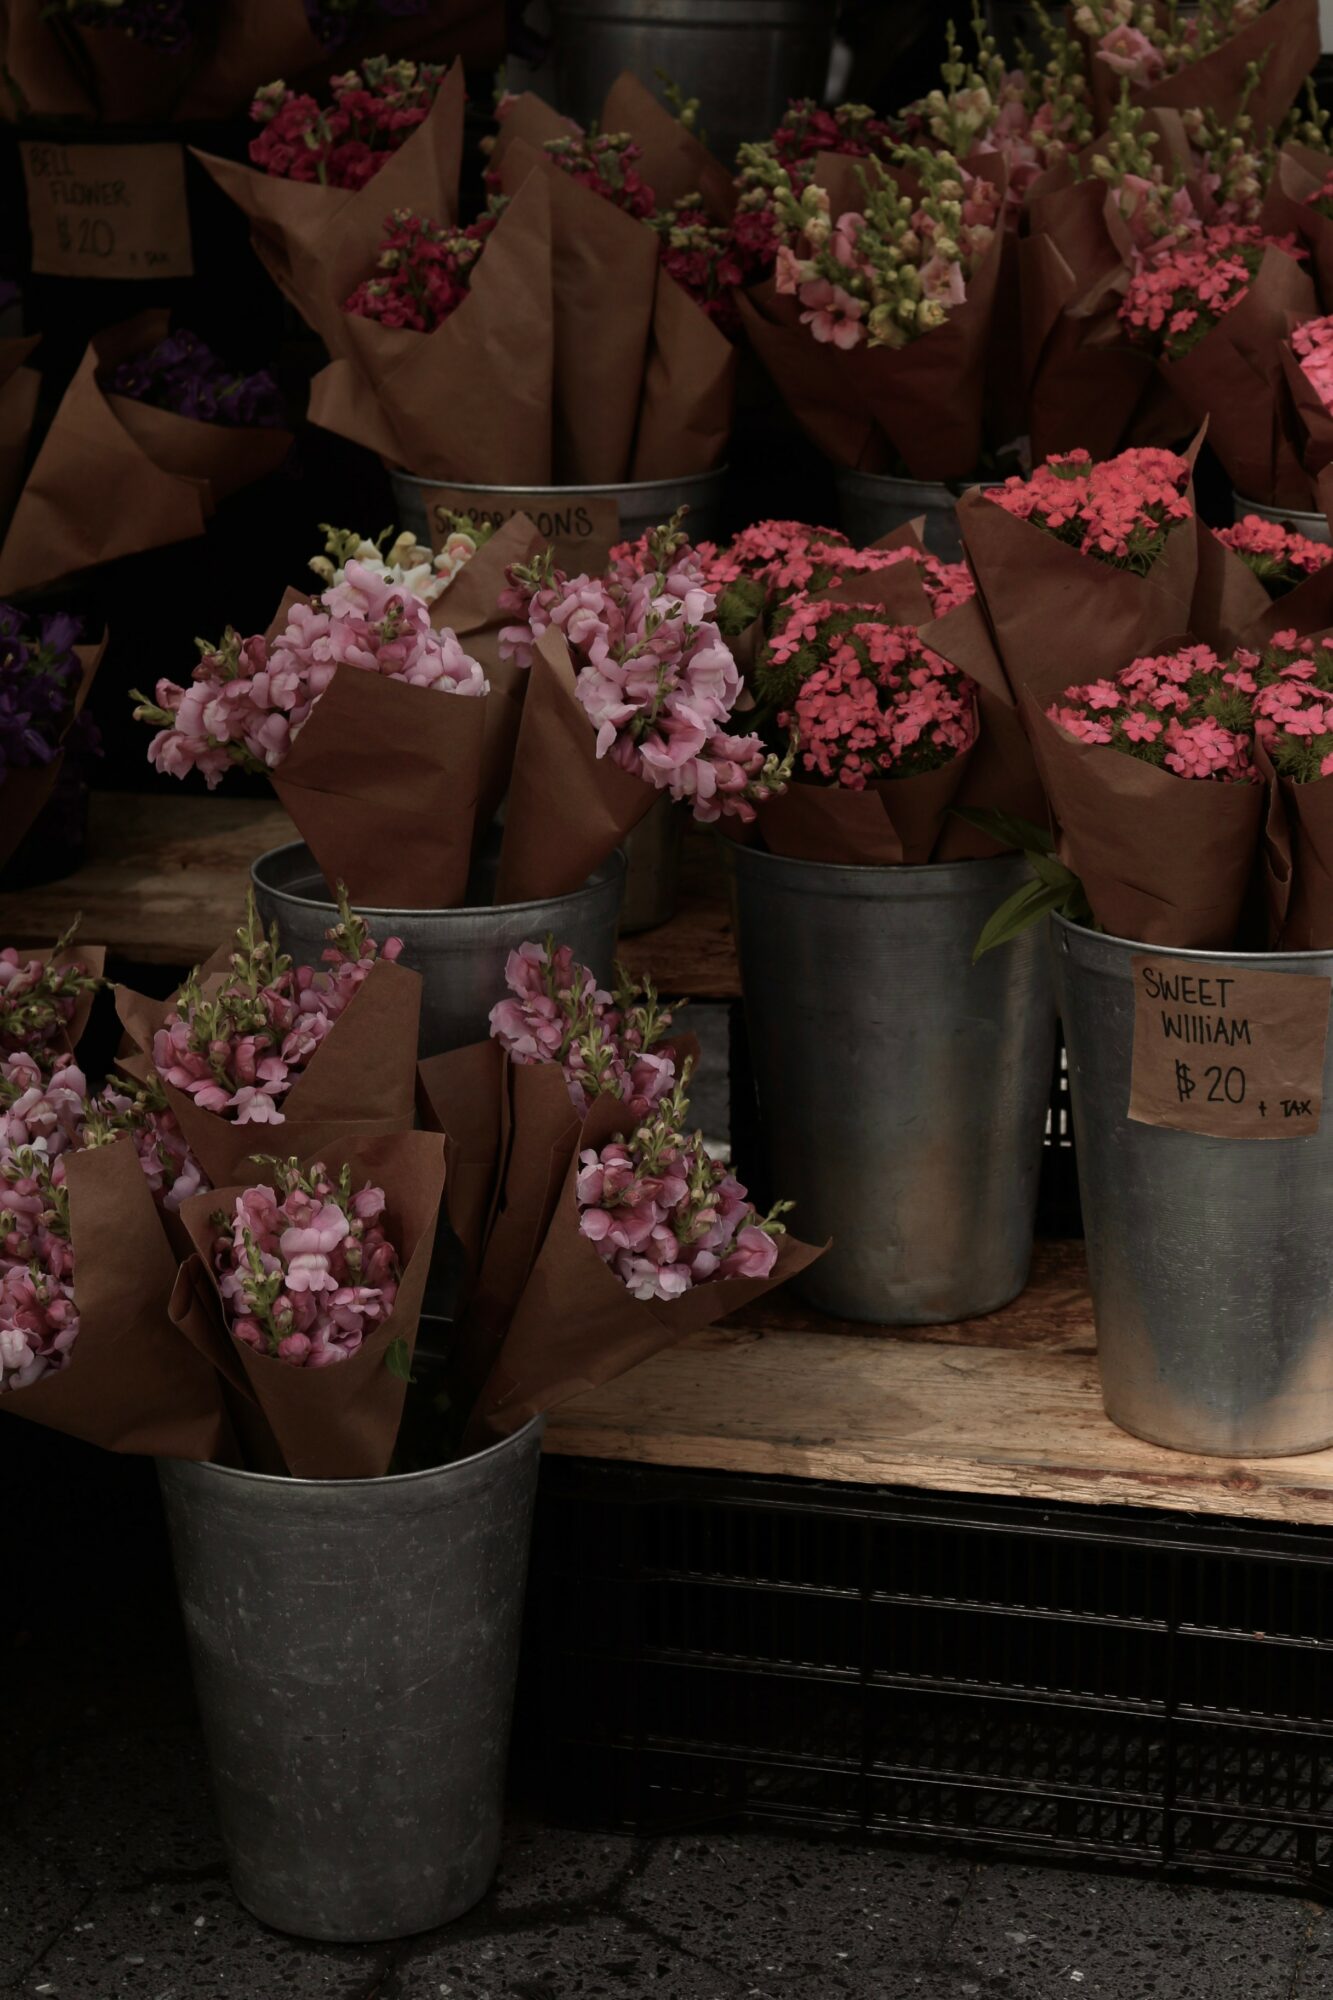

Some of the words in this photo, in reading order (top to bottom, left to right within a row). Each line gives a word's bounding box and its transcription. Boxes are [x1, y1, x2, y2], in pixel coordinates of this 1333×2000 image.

[29, 146, 75, 177] BELL
[49, 178, 131, 208] FLOWER
[1142, 967, 1235, 1008] SWEET
[1279, 1099, 1313, 1117] TAX
